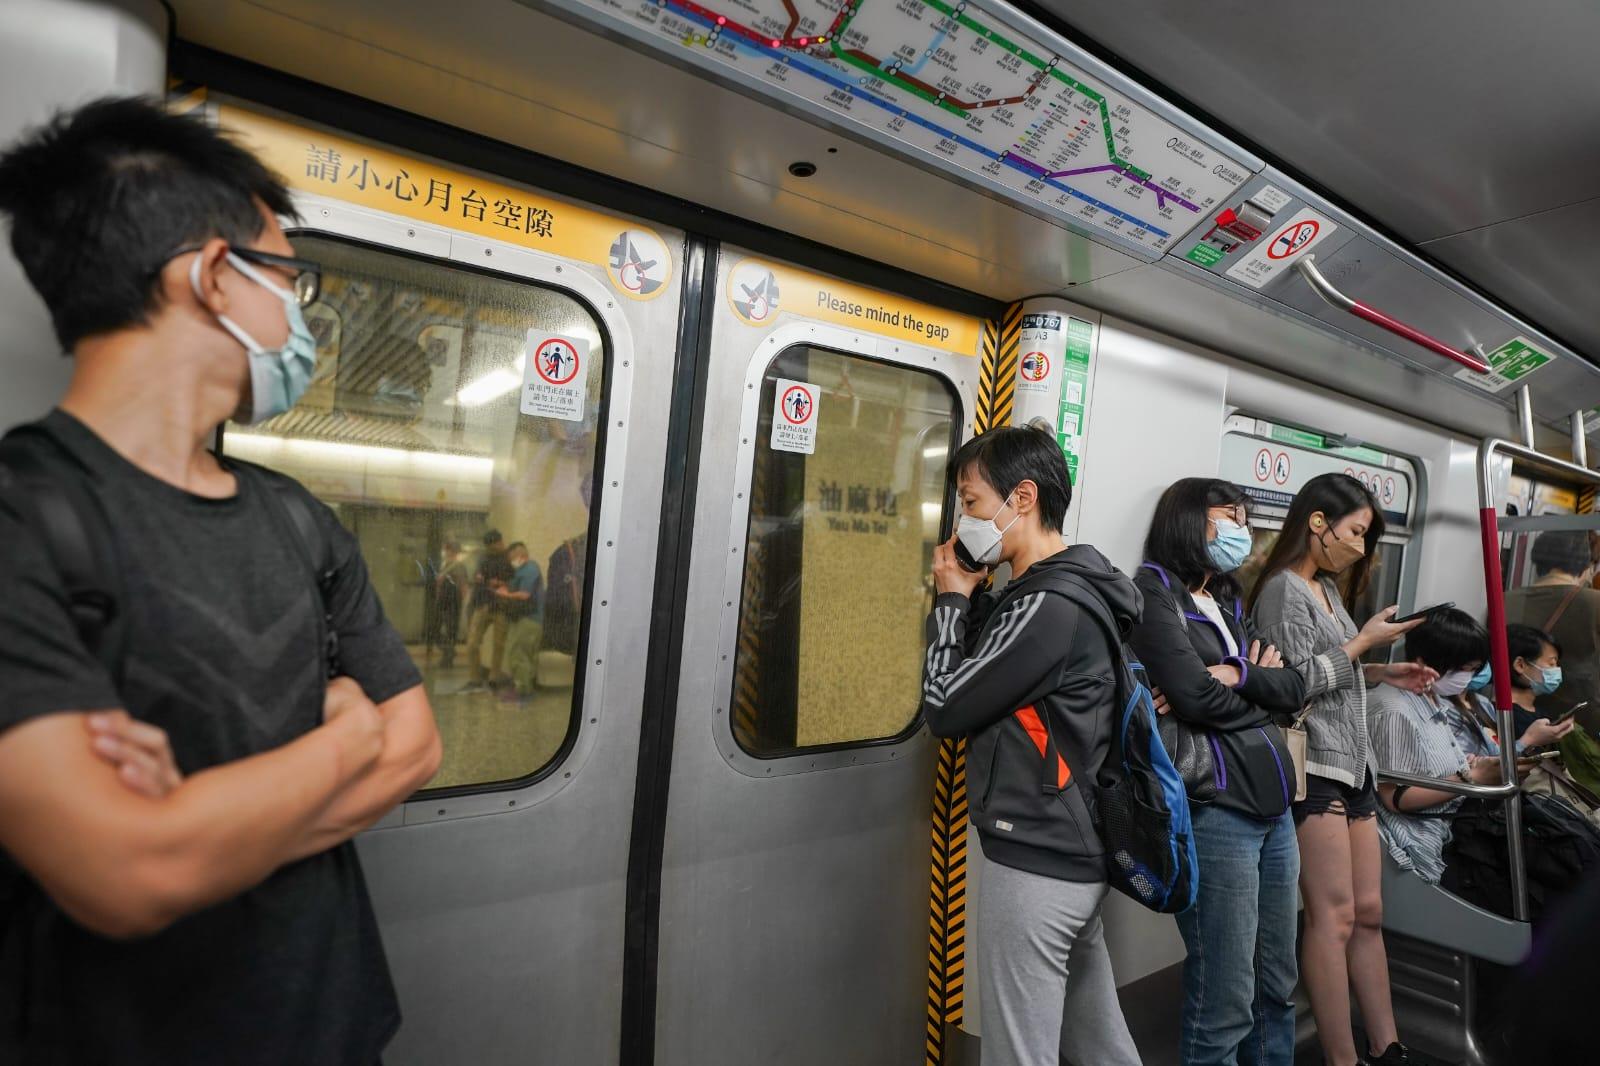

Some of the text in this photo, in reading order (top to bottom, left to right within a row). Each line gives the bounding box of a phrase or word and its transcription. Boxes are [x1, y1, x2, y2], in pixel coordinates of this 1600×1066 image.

[305, 144, 555, 239] 請小心月台空隙
[817, 290, 950, 341] Please mind the gap
[1036, 316, 1060, 328] D767
[1035, 331, 1048, 340] A3
